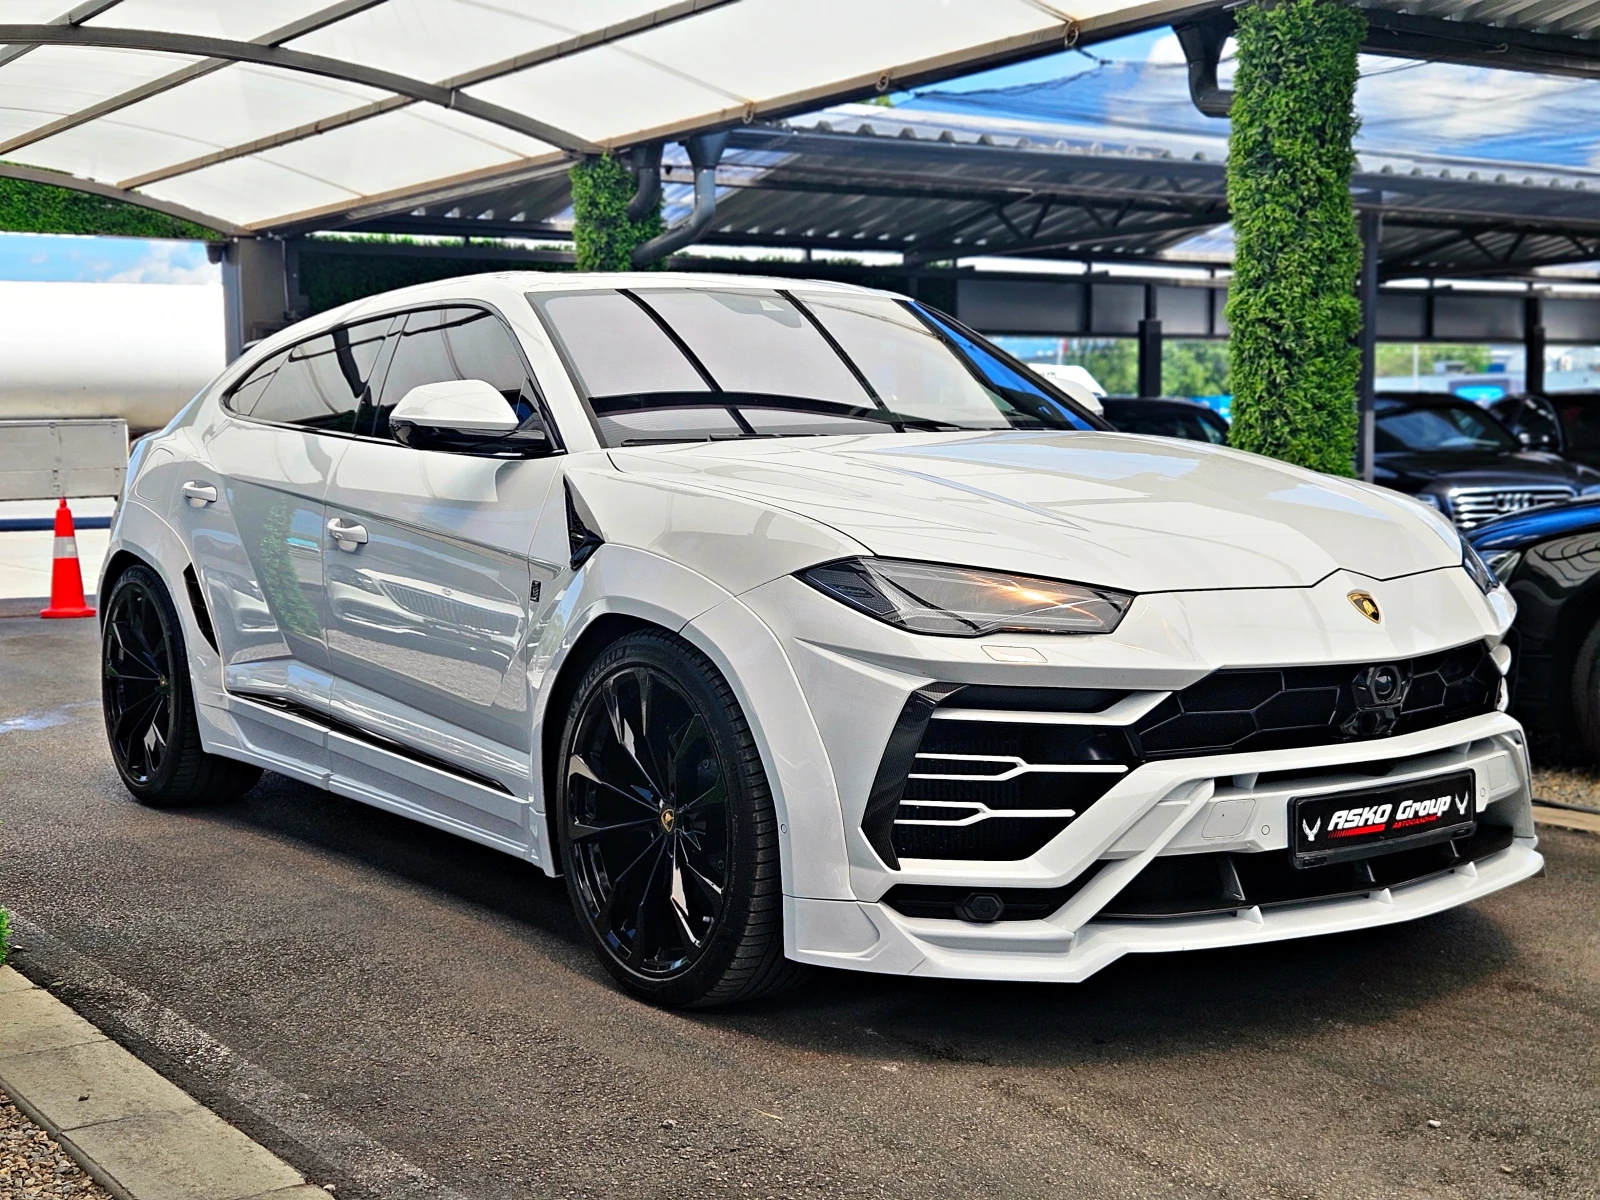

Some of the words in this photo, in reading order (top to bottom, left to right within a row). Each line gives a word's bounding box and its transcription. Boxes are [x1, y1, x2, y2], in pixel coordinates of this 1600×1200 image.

[578, 646, 626, 698] MICHELIN
[1327, 804, 1392, 831] ASKO
[1395, 795, 1452, 820] Group
